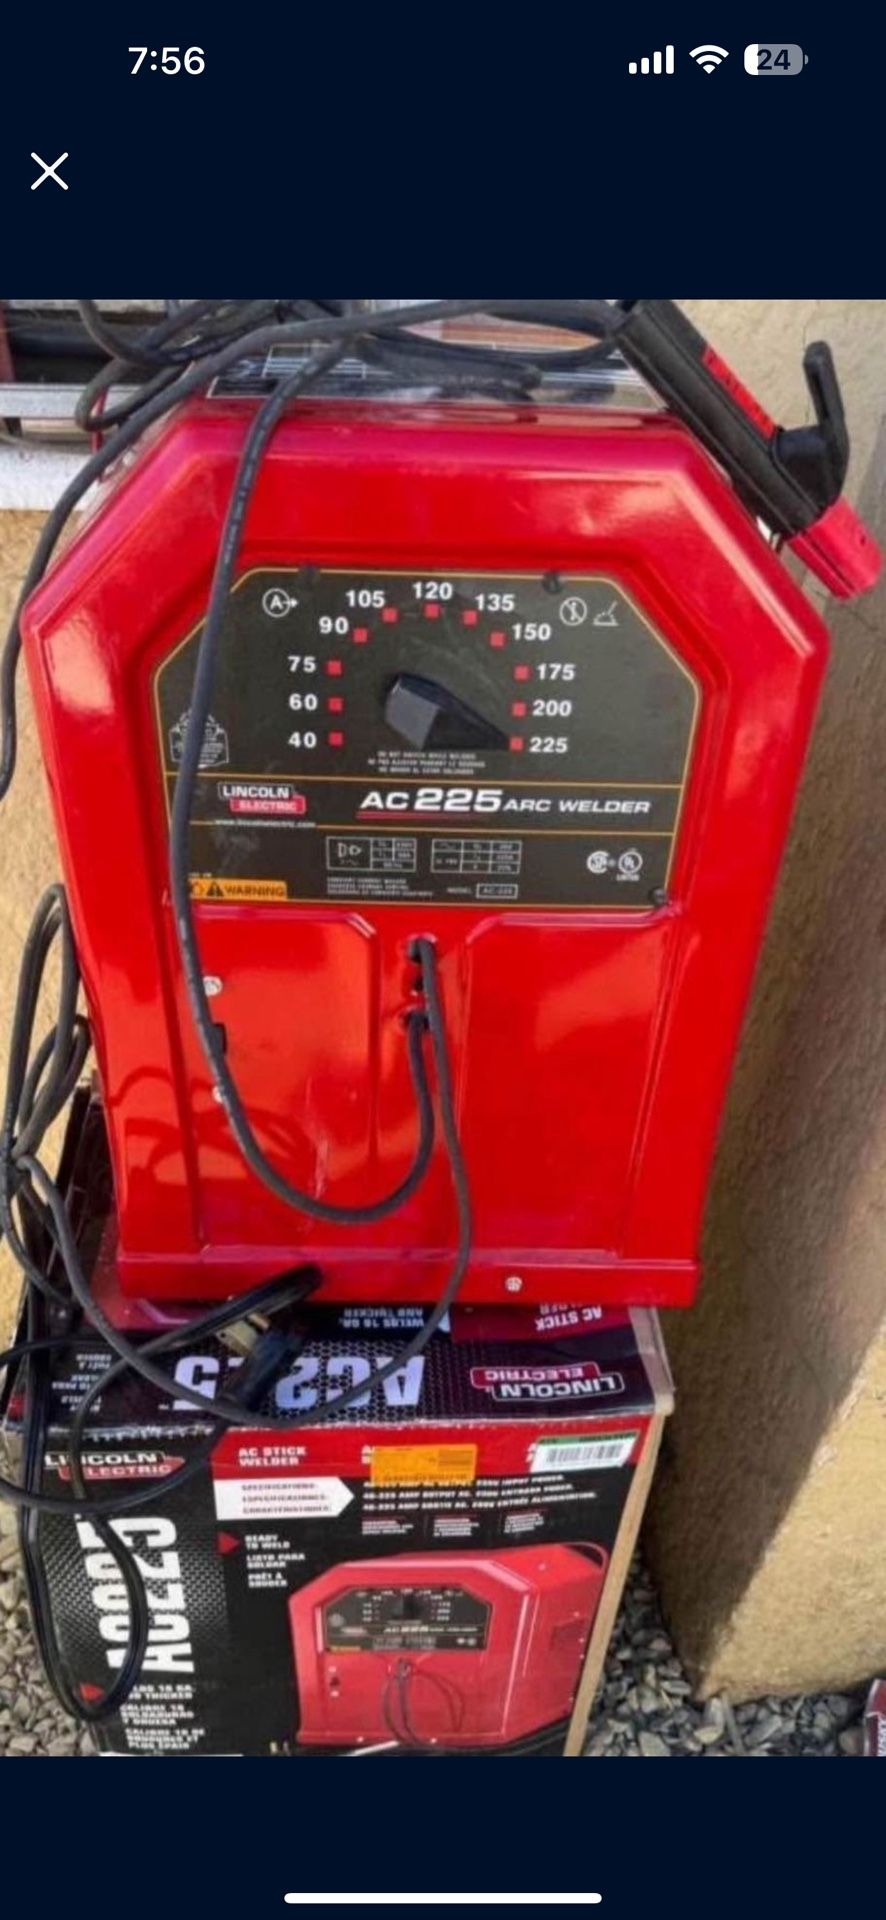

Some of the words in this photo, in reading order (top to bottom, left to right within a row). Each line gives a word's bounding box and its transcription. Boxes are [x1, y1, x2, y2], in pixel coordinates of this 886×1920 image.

[346, 590, 386, 608] 105
[412, 582, 453, 600] 120
[475, 594, 515, 612] 135
[319, 617, 349, 634] 90
[512, 623, 552, 641] 150
[288, 656, 316, 672] 75
[537, 664, 576, 681] 175
[288, 694, 318, 711] 60
[532, 700, 572, 717] 200
[288, 732, 317, 748] 40
[529, 738, 568, 753] 225
[222, 786, 289, 798] LINCOLN
[239, 800, 297, 812] ELECTRIC
[360, 791, 409, 810] AC
[413, 787, 503, 812] 225
[502, 799, 551, 812] ARC
[559, 800, 651, 815] WELDER
[224, 884, 285, 898] WARNING
[535, 1311, 577, 1331] STICK
[580, 1306, 602, 1320] AC
[174, 1355, 425, 1410] AC25
[485, 1366, 584, 1383] ELECTRIC
[501, 1373, 616, 1399] LINCOLN
[239, 1447, 258, 1457] AC
[262, 1446, 306, 1457] STICK
[240, 1456, 299, 1466] WELDER
[82, 1465, 173, 1477] LECTRIC
[261, 1541, 290, 1550] WELD
